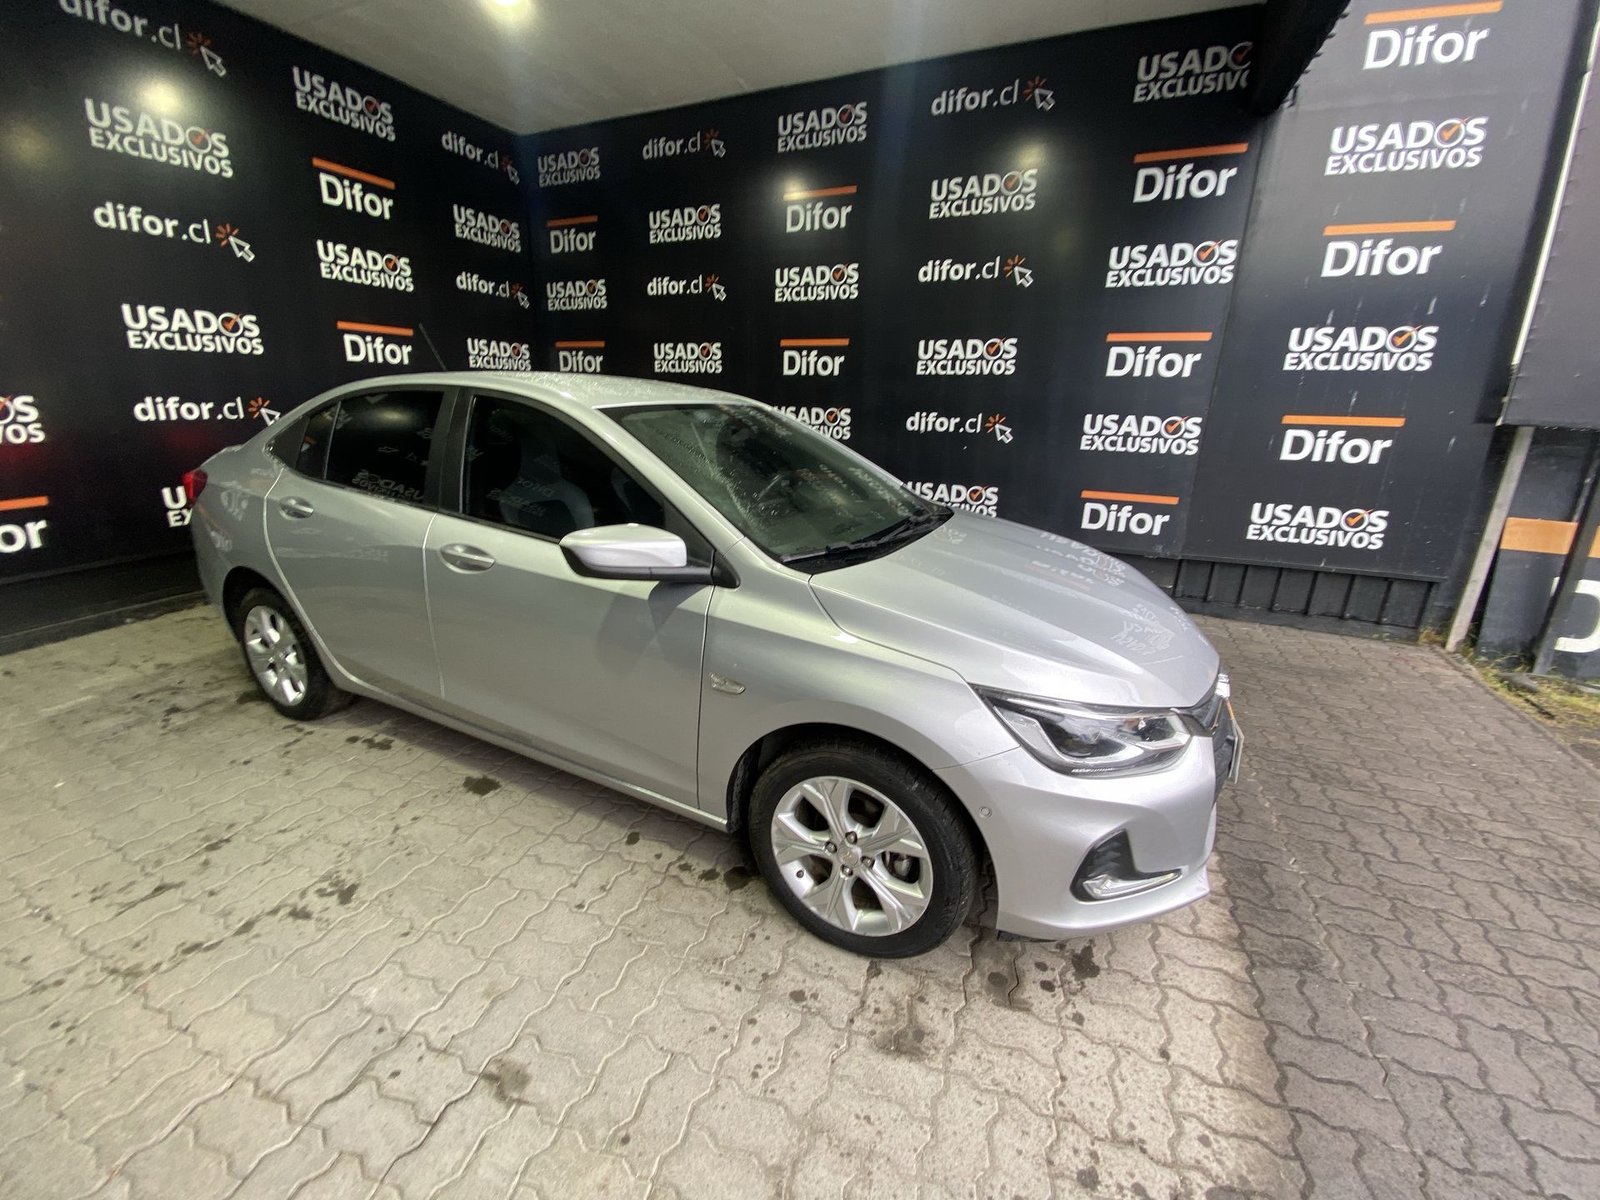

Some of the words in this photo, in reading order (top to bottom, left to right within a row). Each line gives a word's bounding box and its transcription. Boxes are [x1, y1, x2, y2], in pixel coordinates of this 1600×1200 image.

[1363, 24, 1490, 70] Difor
[1137, 41, 1253, 82] USADO
[292, 66, 393, 125] USADOS
[931, 78, 1019, 116] difor.cl
[1133, 69, 1250, 103] EXCLUSIV
[84, 98, 229, 158] USADOS
[295, 90, 396, 142] EXCLUSIVOS
[778, 101, 867, 136] USADOS
[642, 131, 700, 160] difor.cl
[777, 125, 867, 153] EXCLUSIVOS
[1330, 116, 1488, 154] USADOS
[89, 127, 234, 178] EXCLUSIVOS
[441, 131, 499, 169] difor.cl
[538, 147, 599, 174] USADOS
[1324, 147, 1484, 177] EXCLUSIVOS
[539, 167, 600, 188] EXCLUSIVOS
[930, 168, 1038, 201] USADOS
[1133, 163, 1238, 203] Difor
[319, 172, 393, 220] Difor
[929, 193, 1035, 219] EXCLUSIVOS
[93, 201, 211, 244] difor.cl
[453, 204, 520, 239] USADOS
[649, 204, 721, 229] USADOS
[786, 202, 852, 233] Difor
[455, 223, 521, 253] EXCLUSIVOS
[550, 229, 596, 254] Difor
[649, 223, 721, 244] EXCLUSIVOS
[316, 239, 412, 277] USADOS
[1109, 239, 1239, 270] USADOS
[1321, 238, 1443, 278] Difor
[320, 262, 414, 293] EXCLUSIVOS
[775, 263, 859, 287] USADOS
[918, 256, 1000, 283] difor.cl
[1105, 265, 1235, 288] EXCLUSIVOS
[456, 271, 510, 298] difor.cl
[547, 279, 606, 298] USADOS
[647, 274, 702, 296] difor.cl
[774, 285, 859, 302] EXCLUSIVOS
[548, 296, 607, 311] EXCLUSIVOS
[121, 303, 260, 338] USADOS
[126, 330, 264, 355] EXCLUSIVOS
[343, 334, 412, 365] Difor
[467, 338, 530, 360] USADOS
[653, 342, 722, 360] USADOS
[918, 337, 1018, 360] USADOS
[1288, 325, 1439, 353] USADOS
[469, 355, 531, 371] EXCLUSIVOS
[559, 350, 603, 373] Difor
[654, 359, 722, 374] EXCLUSIVOS
[783, 350, 845, 376] Difor
[916, 358, 1016, 375] EXCLUSIVOS
[1105, 346, 1202, 378] Difor
[1282, 351, 1434, 372] EXCLUSIVOS
[133, 396, 244, 422] difor.cl
[905, 412, 982, 433] difor.cl
[1083, 414, 1202, 440] USADOS
[1080, 435, 1199, 456] EXCLUSIVOS
[1279, 428, 1392, 464] Difor
[1081, 502, 1170, 536] Difor
[1250, 502, 1389, 533] USADOS
[1246, 525, 1384, 550] EXCLUSIVOS
